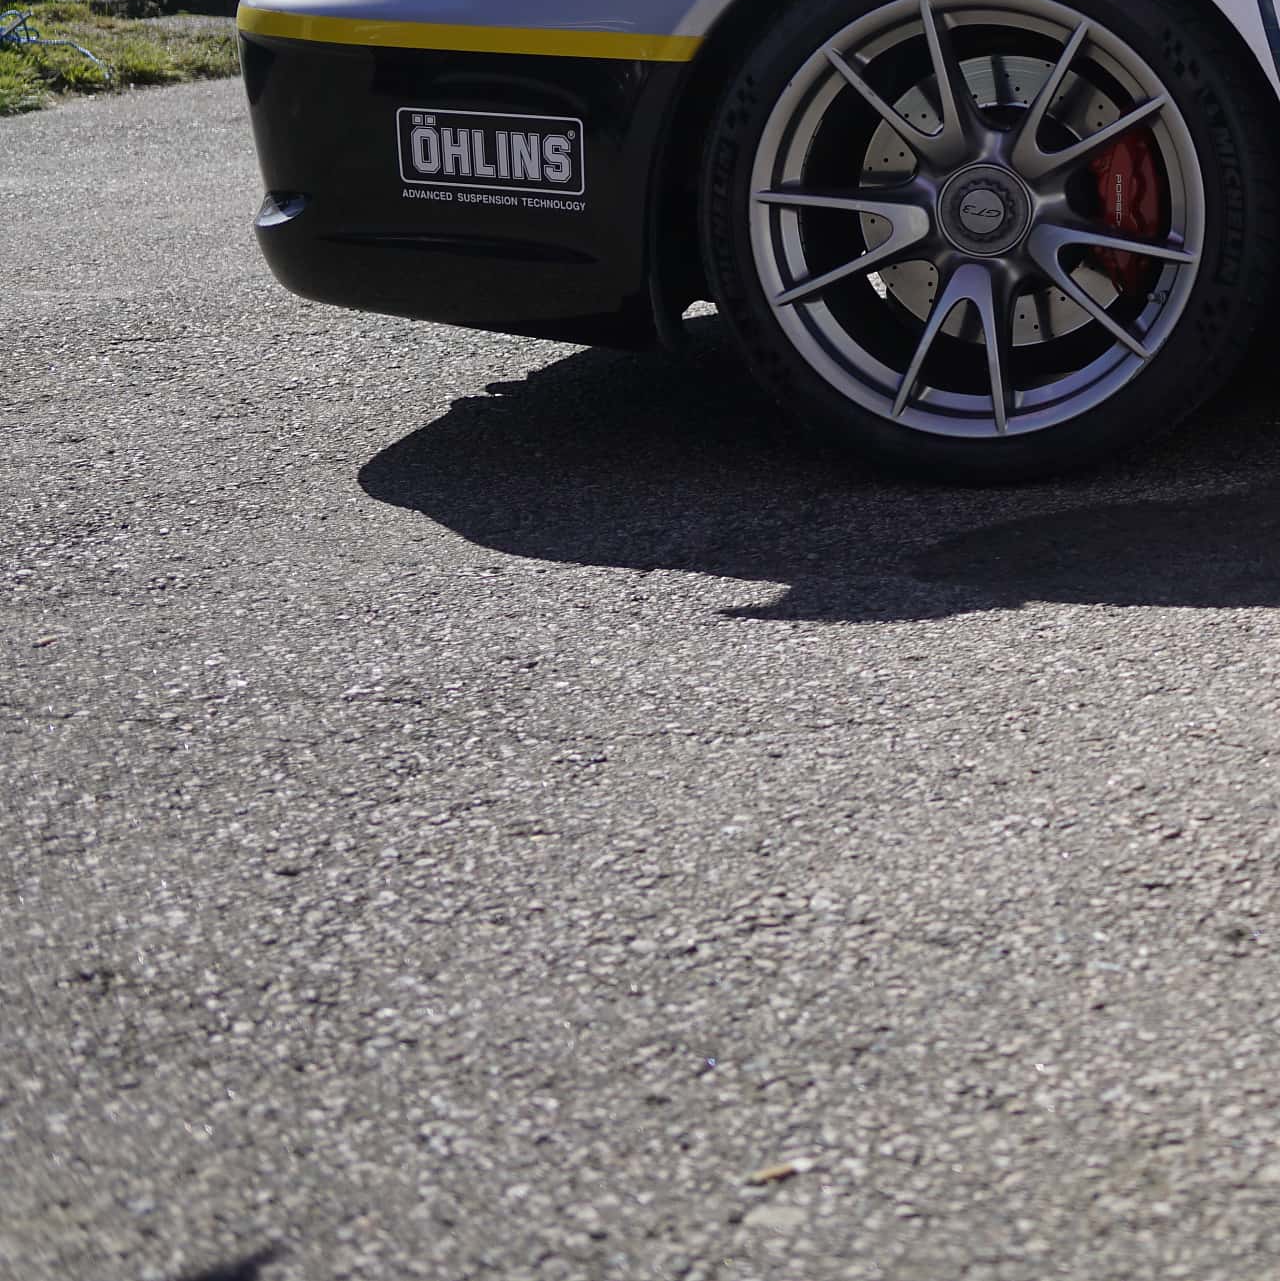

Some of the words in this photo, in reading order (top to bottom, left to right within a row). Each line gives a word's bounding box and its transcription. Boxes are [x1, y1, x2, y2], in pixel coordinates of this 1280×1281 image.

[410, 114, 573, 184] ÖHLINS
[402, 189, 452, 201] ADVANCED
[457, 193, 518, 206] SUSPENSION
[522, 197, 586, 211] TECHNOLOGY
[962, 205, 1001, 218] GT3
